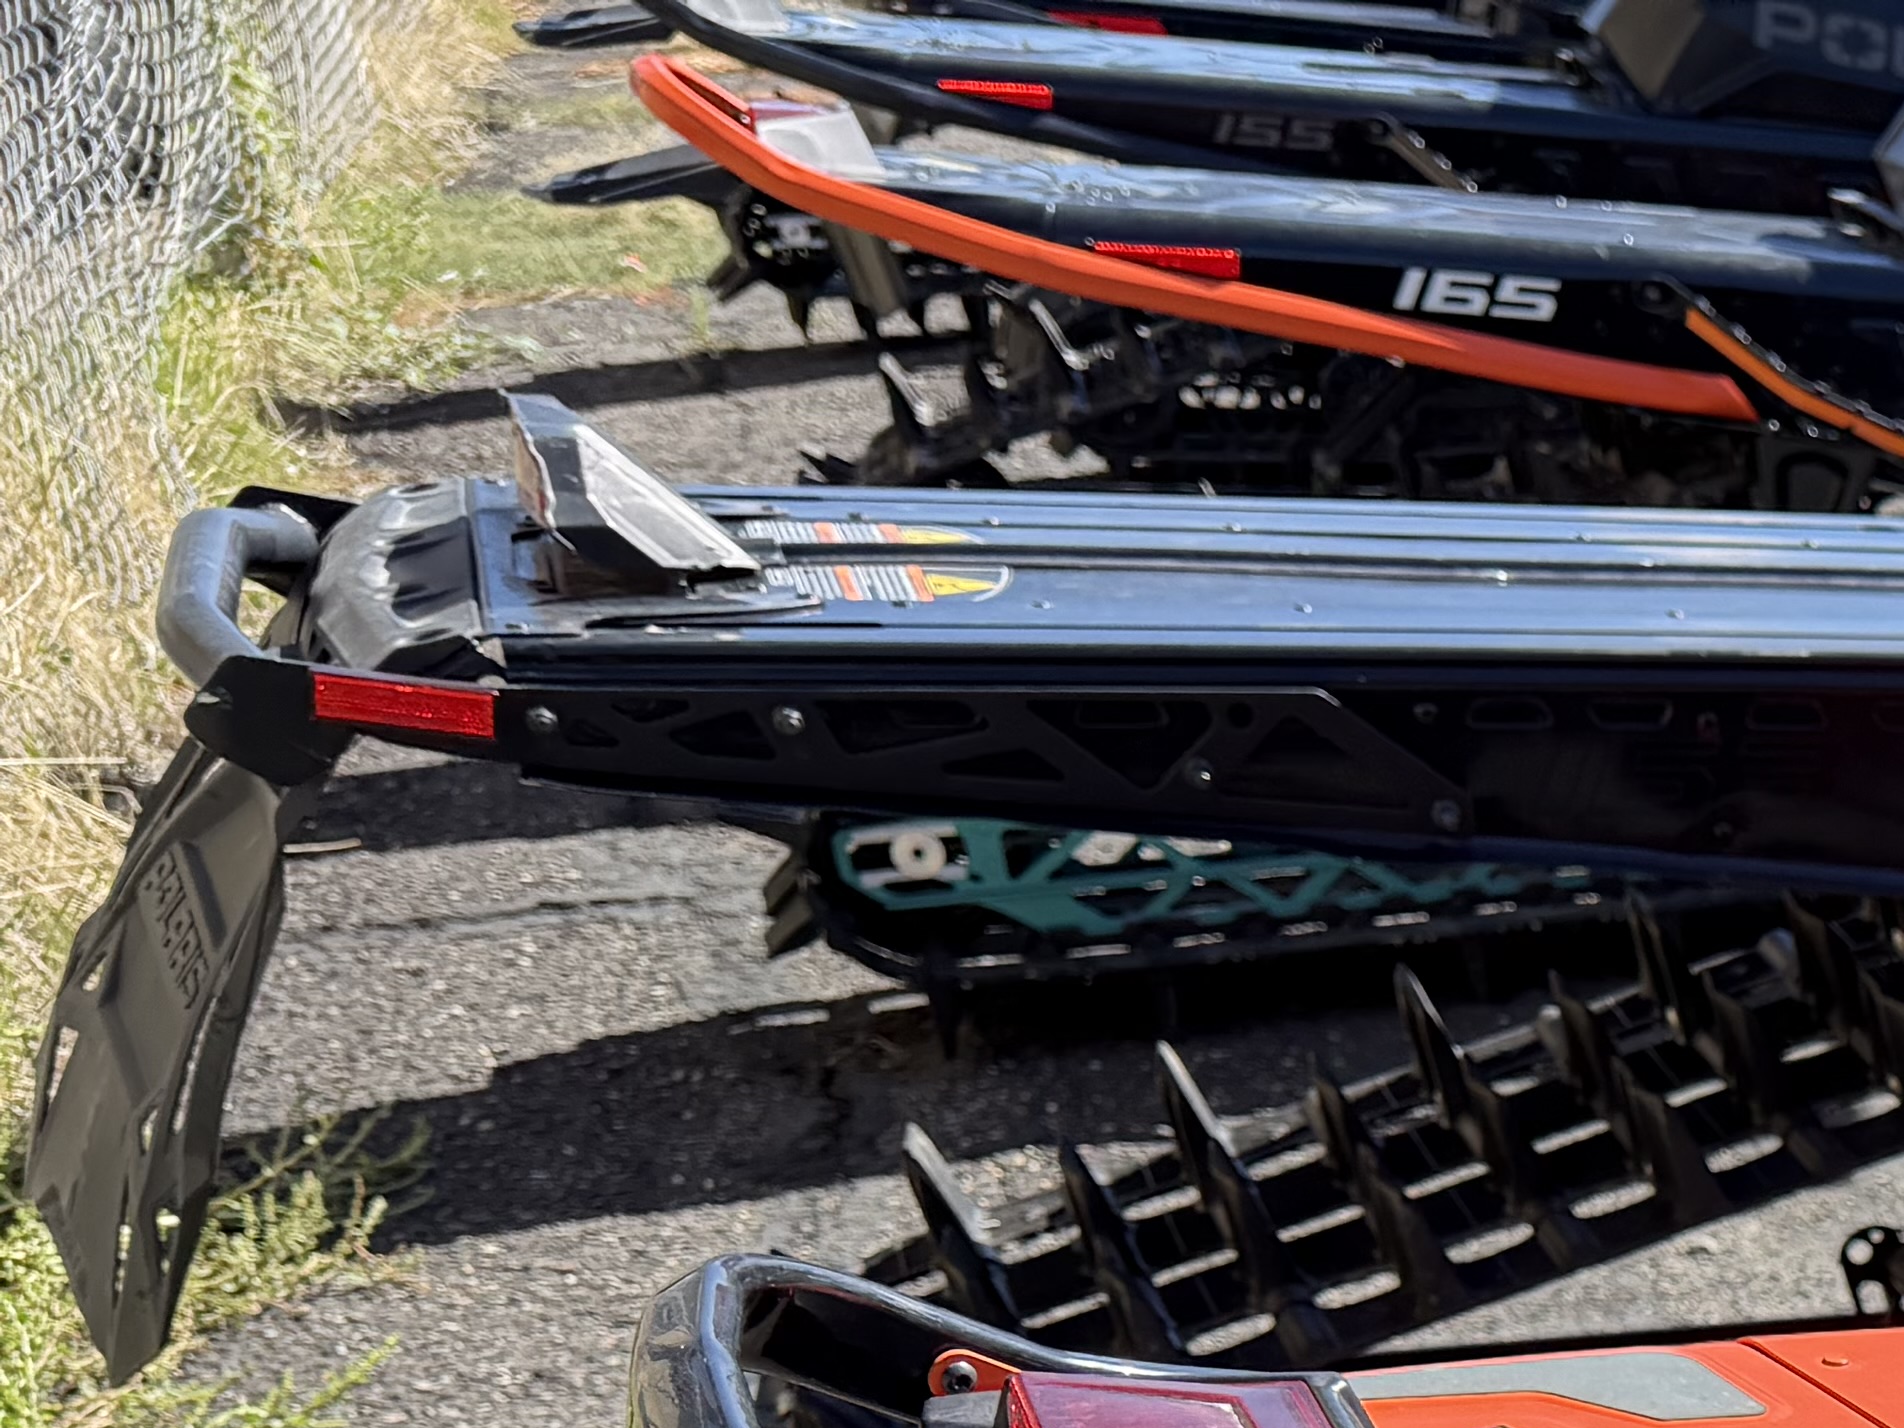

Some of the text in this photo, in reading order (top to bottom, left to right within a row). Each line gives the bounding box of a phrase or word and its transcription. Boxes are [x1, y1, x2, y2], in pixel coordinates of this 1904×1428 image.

[1211, 112, 1337, 152] 155
[1392, 265, 1563, 322] 165
[142, 848, 210, 1010] POLARIS
